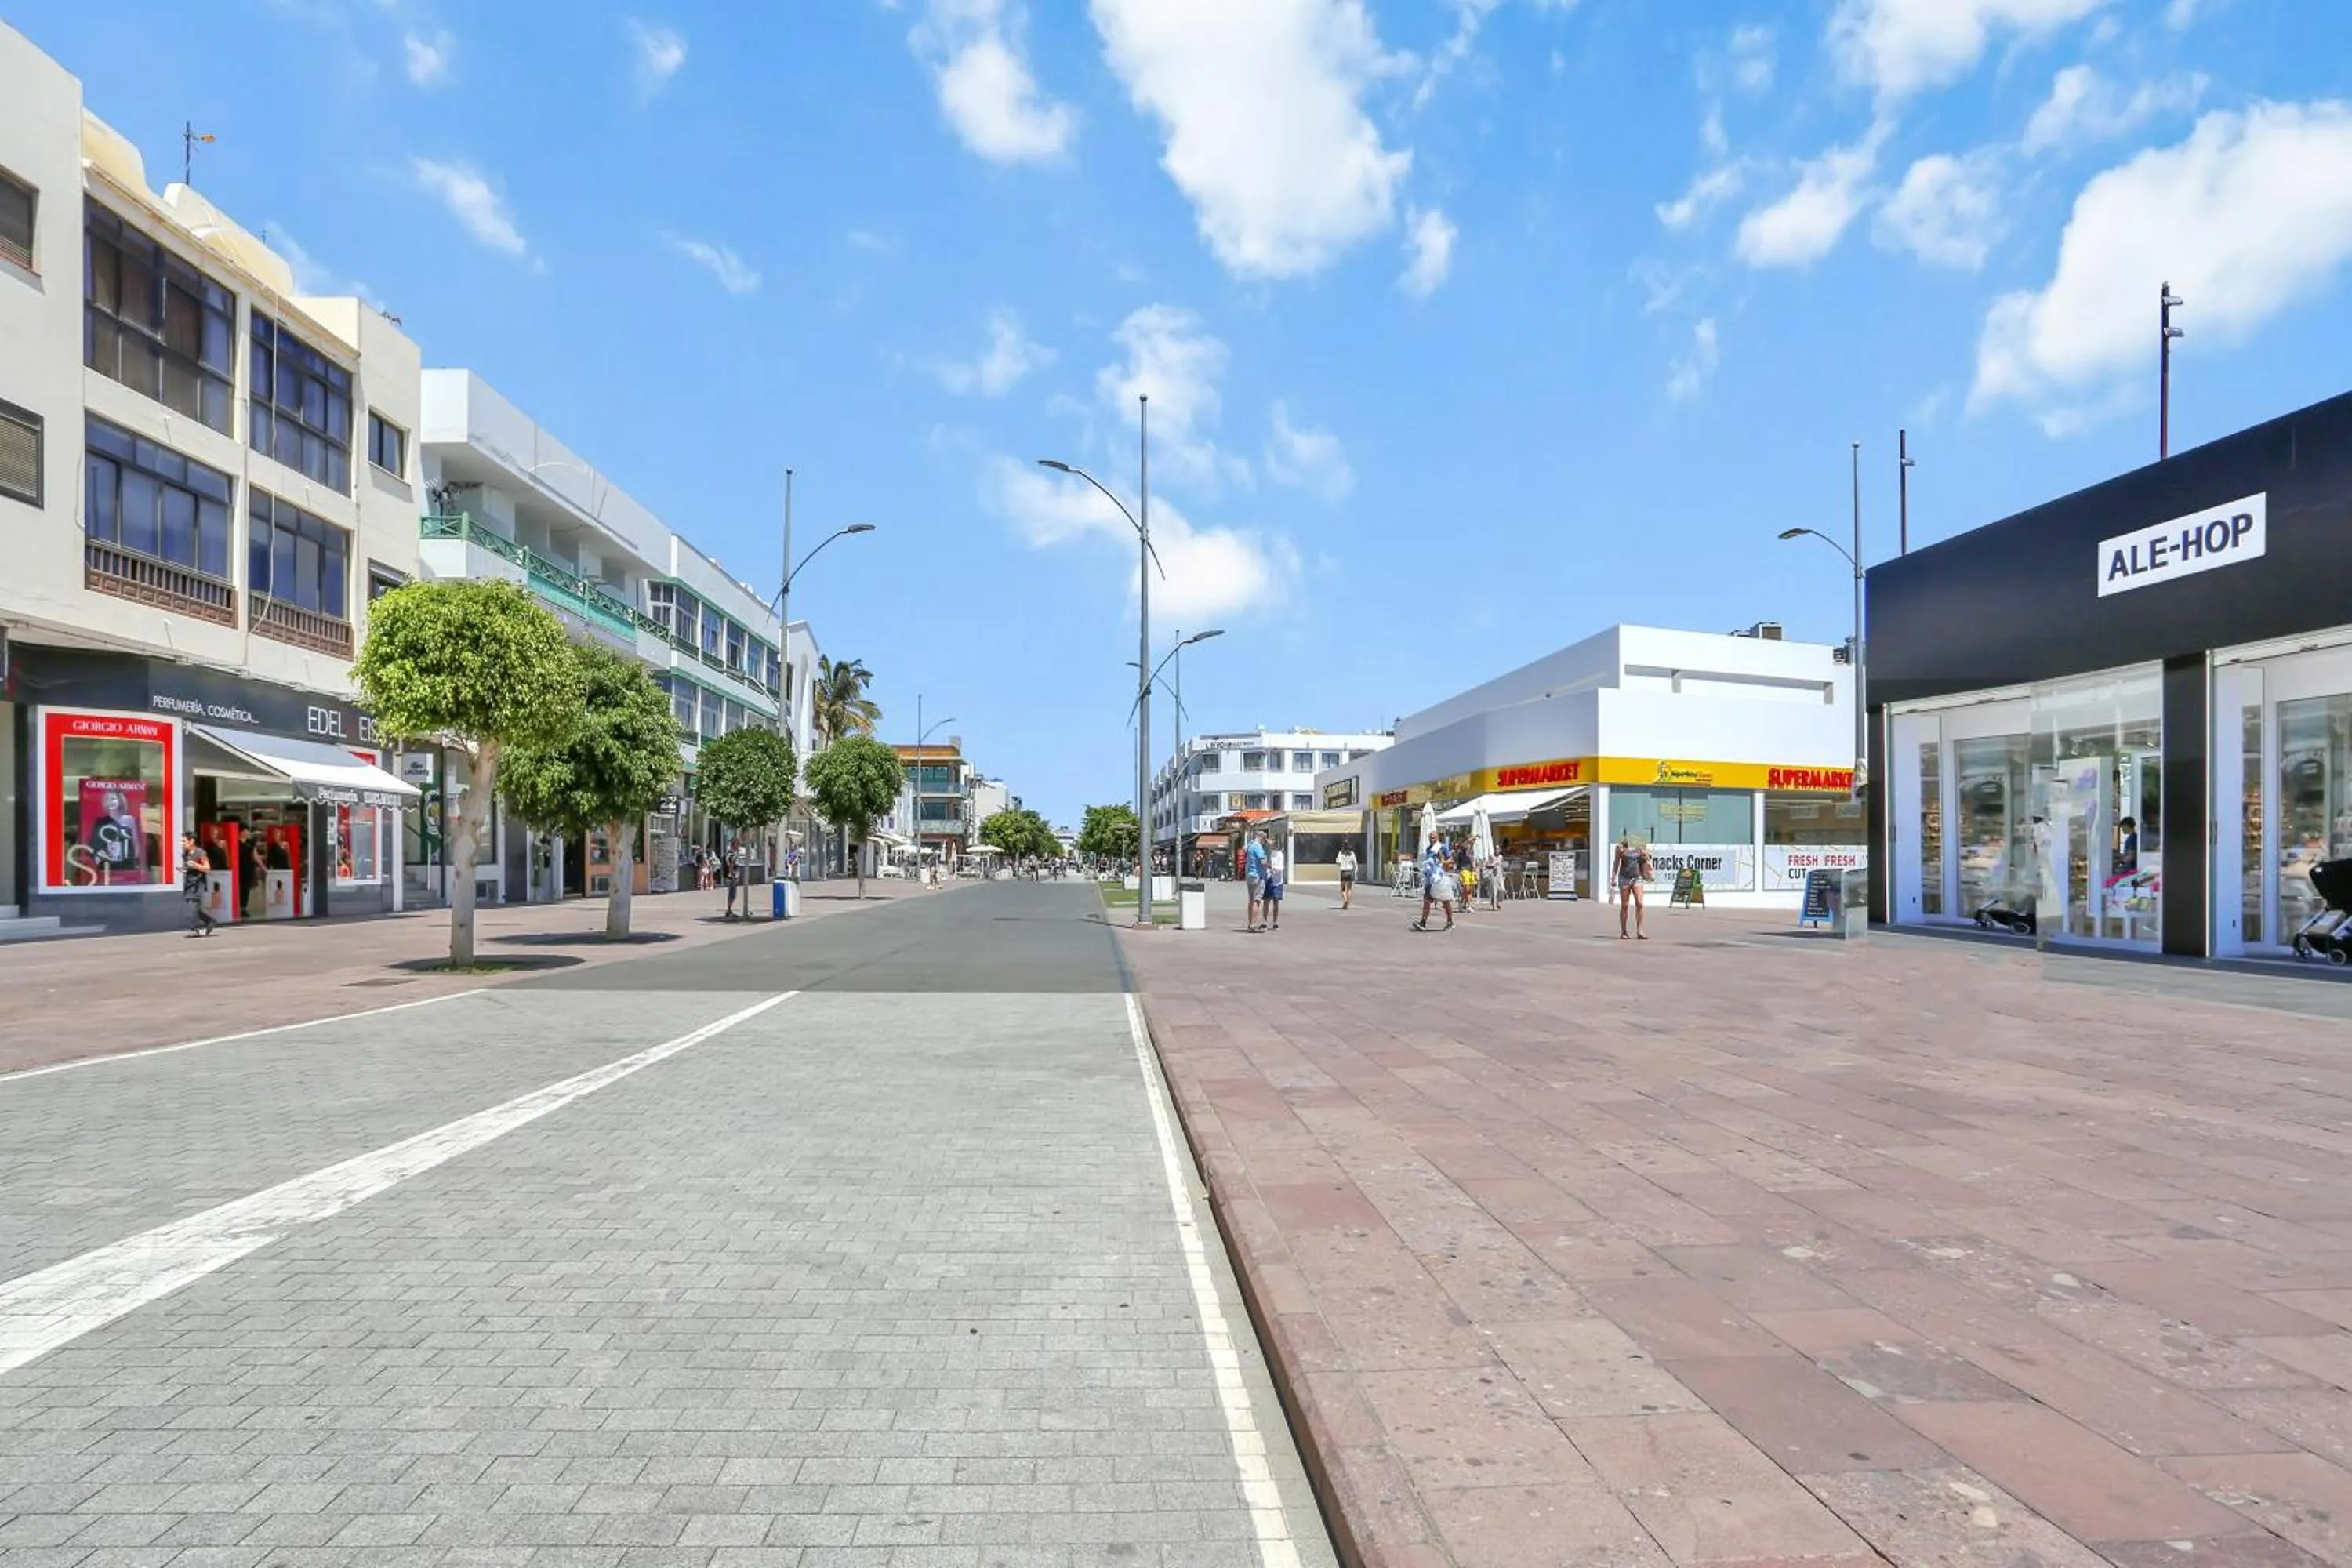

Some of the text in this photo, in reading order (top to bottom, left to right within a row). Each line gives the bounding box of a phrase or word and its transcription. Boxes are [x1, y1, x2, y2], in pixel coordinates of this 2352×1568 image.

[2107, 512, 2254, 581] ALE-HOP
[72, 720, 123, 732] GIORGIO
[308, 706, 347, 738] EDEL
[1497, 761, 1581, 787] SUPERMARKET
[1648, 854, 1722, 871] nacks Corner
[1788, 855, 1857, 866] FRESH FRESH
[1788, 868, 1807, 879] CUT
